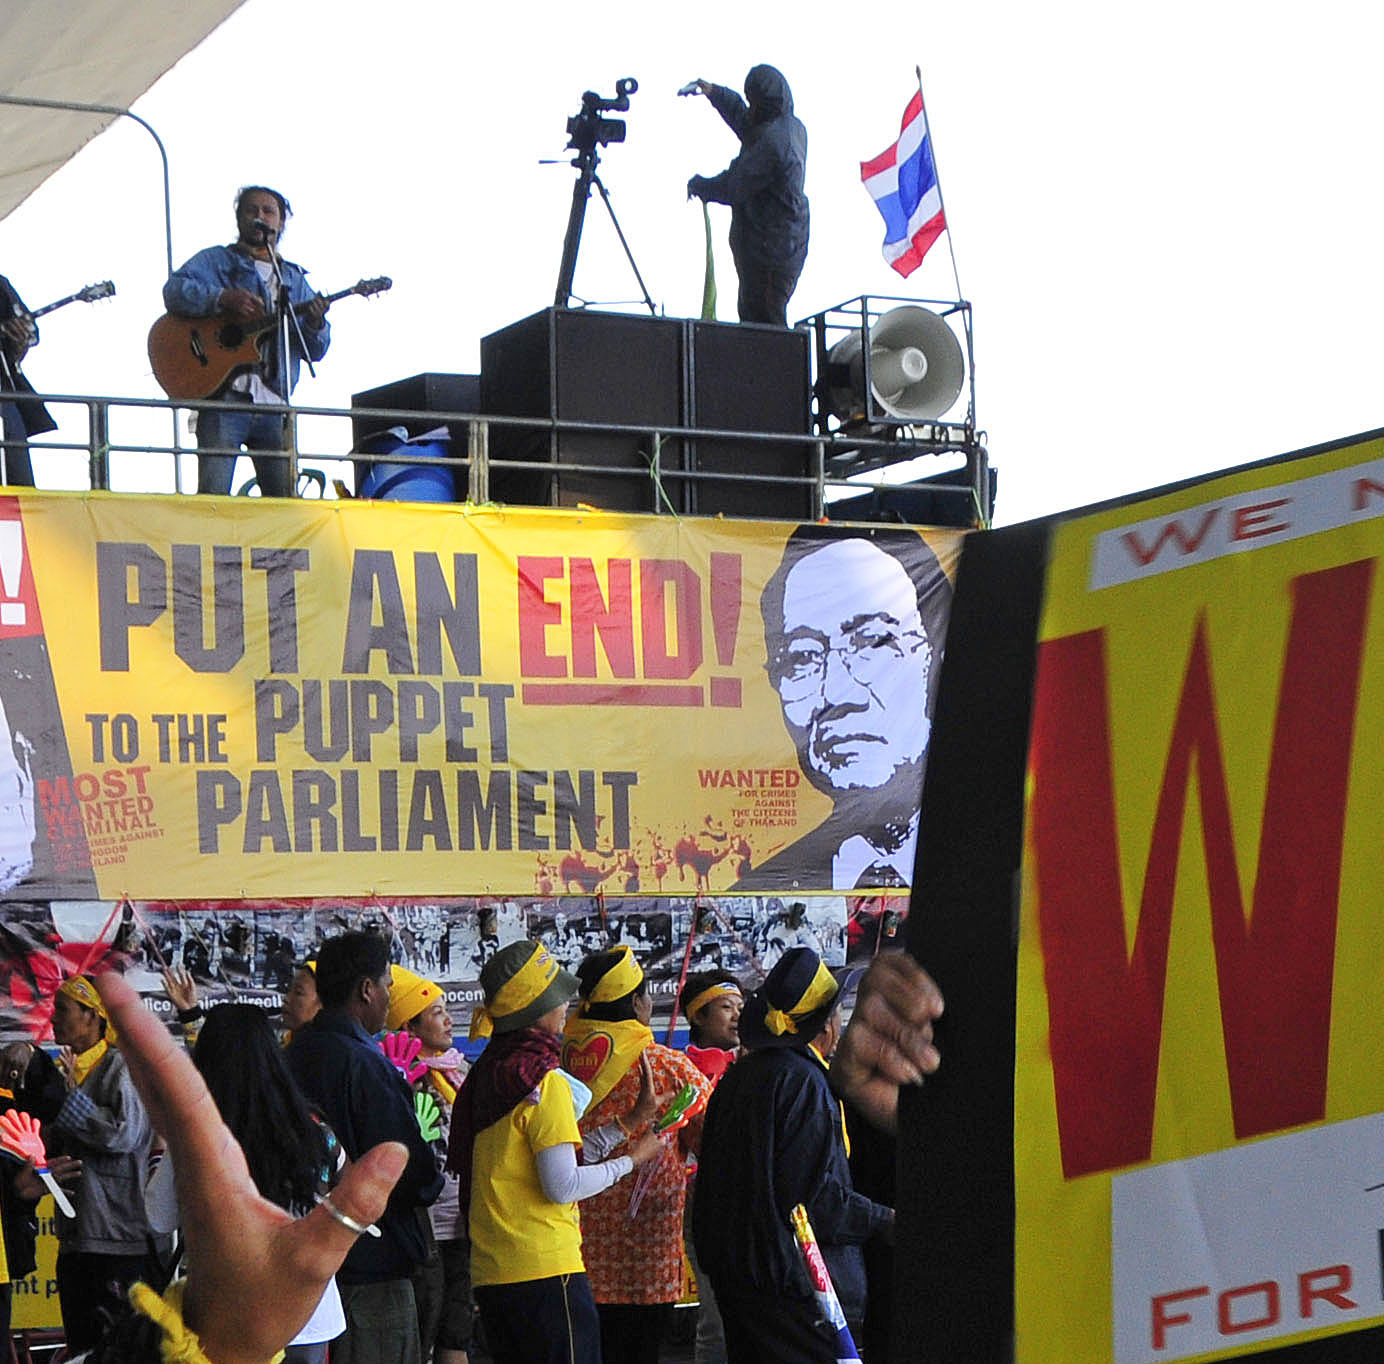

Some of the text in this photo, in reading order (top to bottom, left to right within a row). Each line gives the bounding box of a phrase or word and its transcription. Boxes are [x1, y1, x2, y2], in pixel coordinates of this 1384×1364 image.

[1120, 498, 1290, 567] WE
[96, 541, 743, 708] PUT AN END!
[86, 678, 515, 764] TO THE PUPPET
[37, 765, 152, 808] MOST
[698, 769, 801, 788] WANTED
[761, 789, 797, 798] CRIMES
[197, 770, 639, 854] PARLIAMENT
[750, 808, 797, 817] CITIZENS
[750, 818, 797, 827] THAILAND
[754, 800, 797, 808] AGAINST
[1150, 1264, 1359, 1351] FOR
